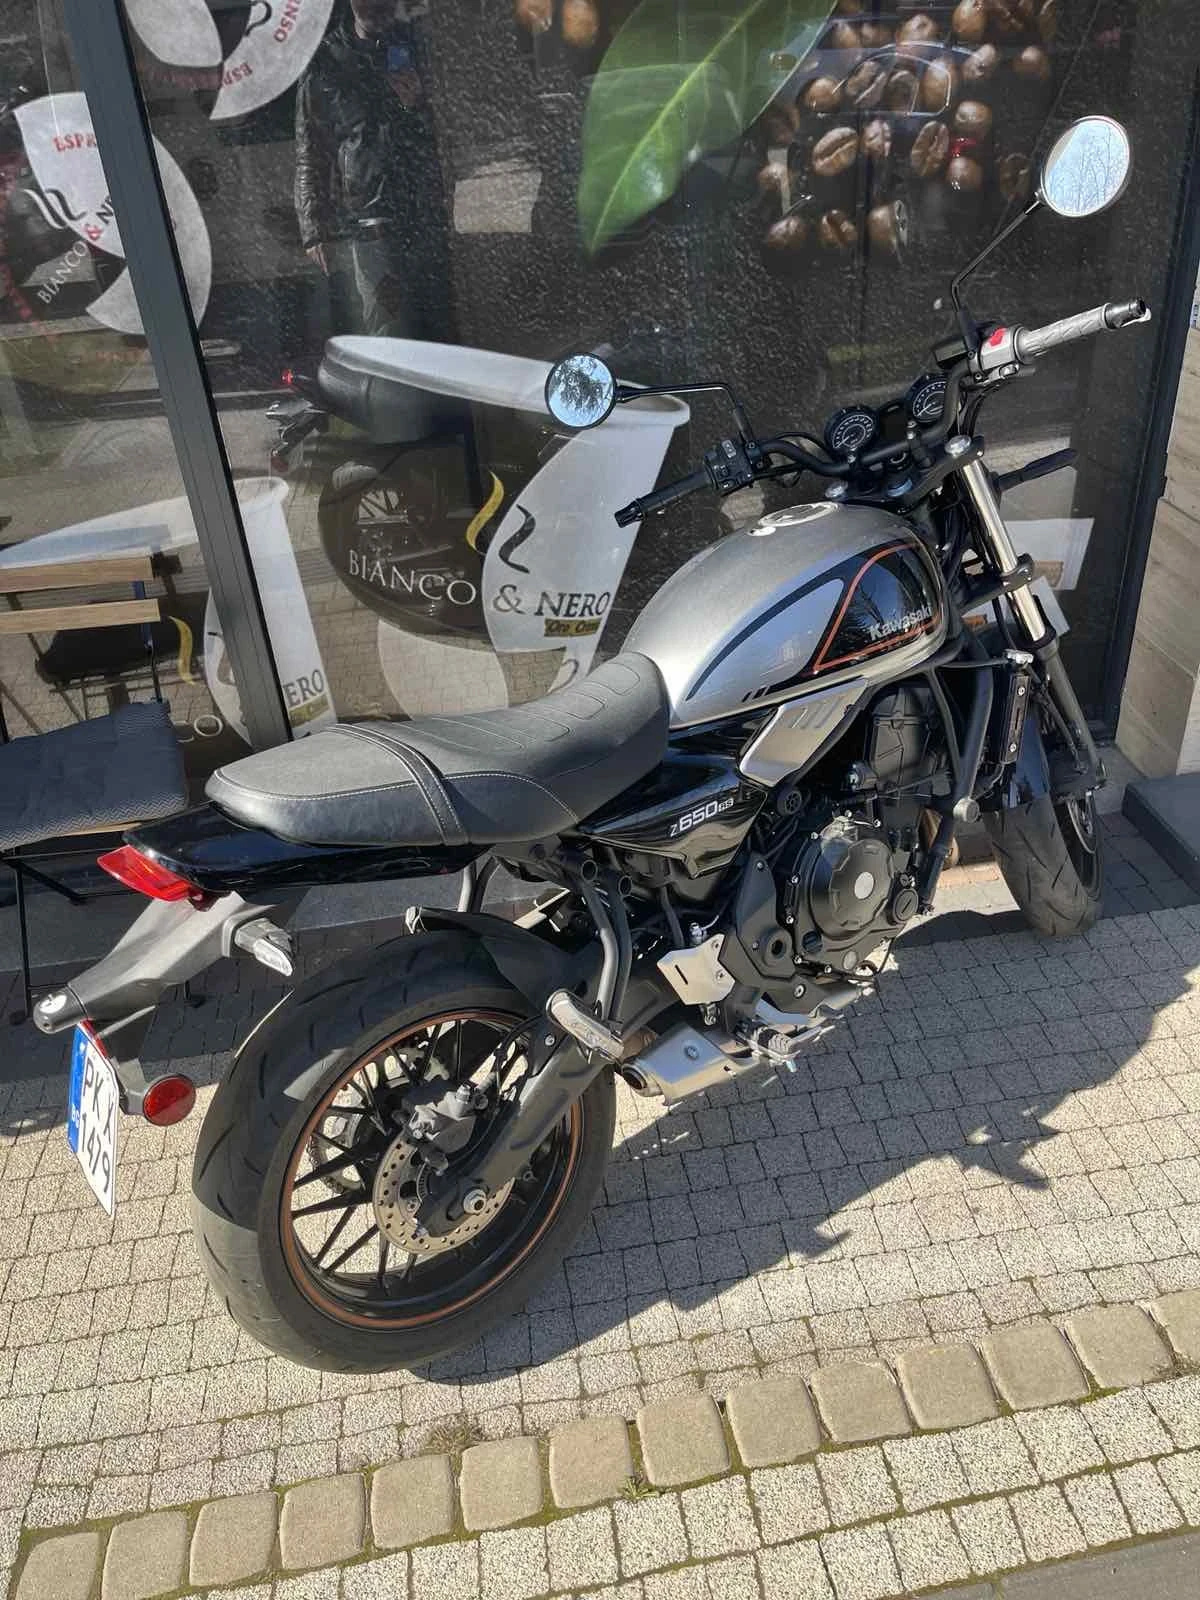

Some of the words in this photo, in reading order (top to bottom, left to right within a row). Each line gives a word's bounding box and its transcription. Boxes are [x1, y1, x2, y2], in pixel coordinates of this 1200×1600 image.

[37, 240, 88, 303] BIANCO
[349, 549, 477, 606] BIANCO
[493, 584, 527, 614] &
[534, 591, 611, 617] NERO
[868, 604, 932, 641] Kawasaki
[82, 1112, 111, 1193] 1479
